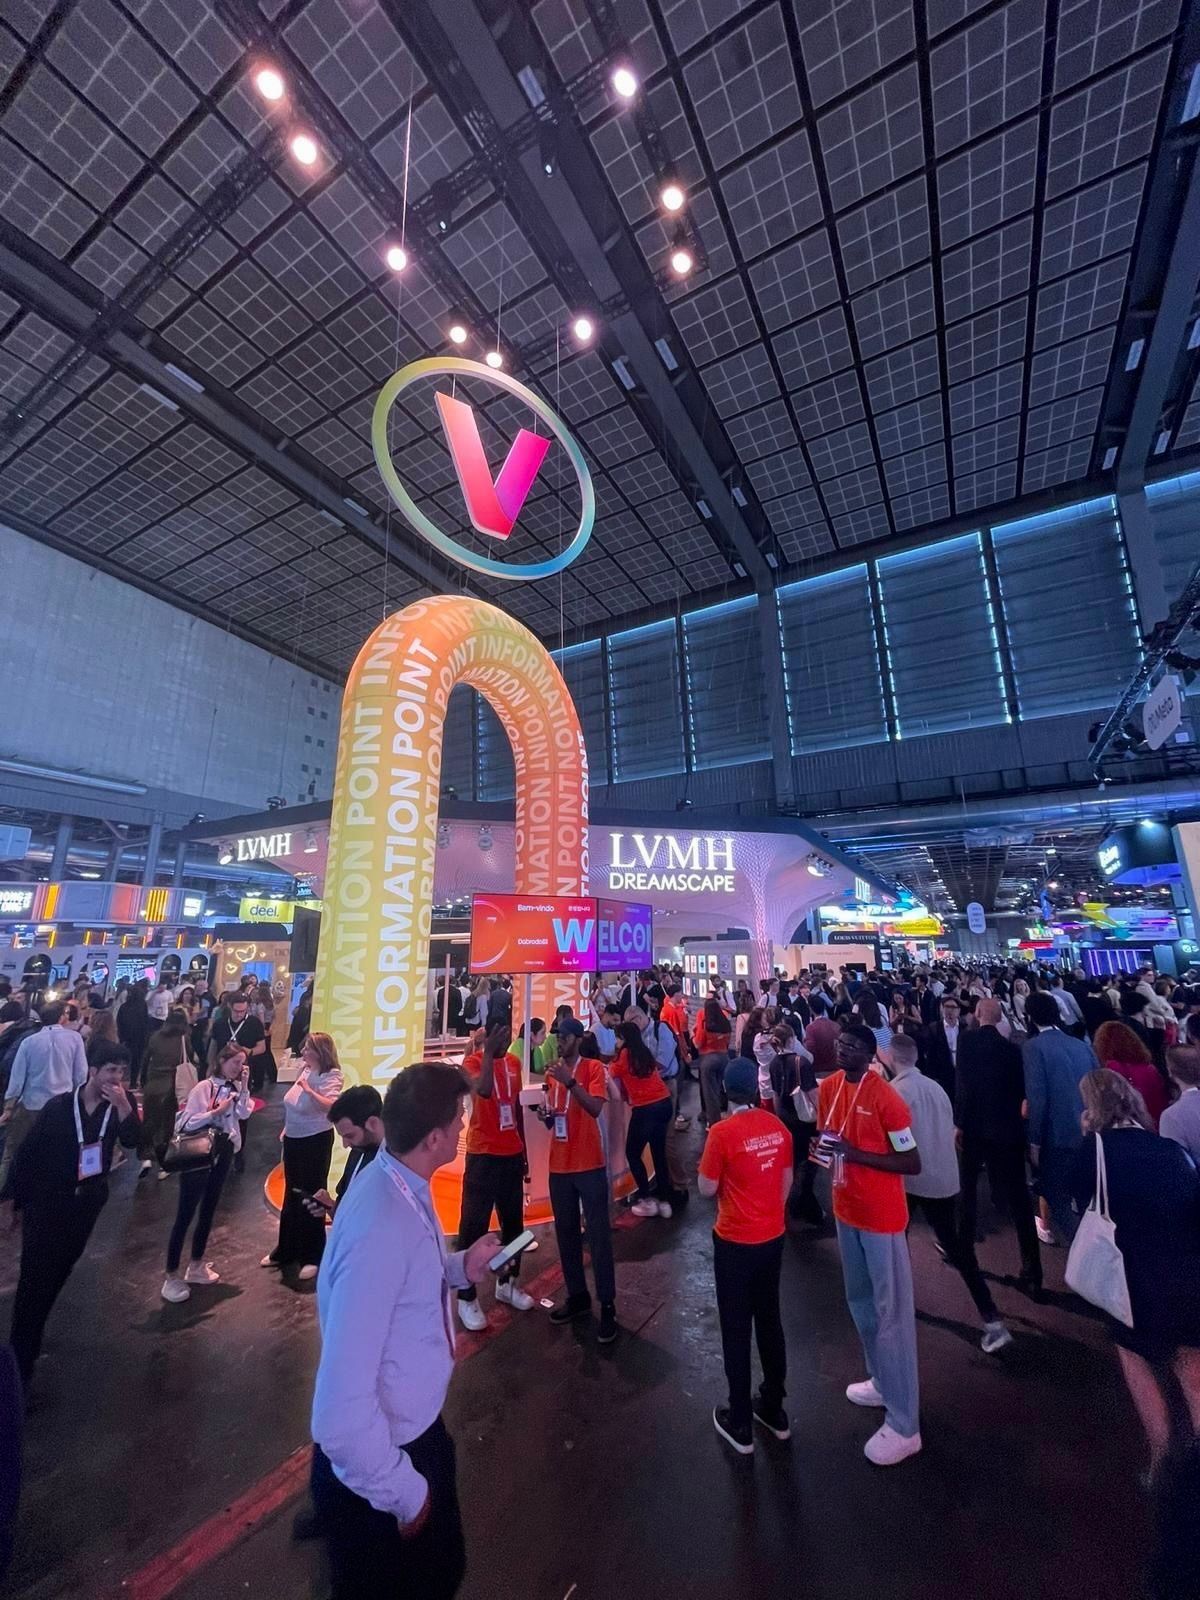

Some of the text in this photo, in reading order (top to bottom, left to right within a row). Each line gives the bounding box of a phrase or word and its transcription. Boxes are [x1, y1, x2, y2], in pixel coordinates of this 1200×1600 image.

[392, 637, 438, 759] POINT
[480, 635, 577, 769] INFORMATION
[346, 701, 384, 826] POINT
[518, 704, 549, 771] POINT
[237, 832, 293, 861] LVMH
[557, 773, 578, 867] POINT
[609, 833, 736, 871] LVMH
[249, 904, 280, 918] deel.
[609, 872, 735, 892] DREAMSCAPE
